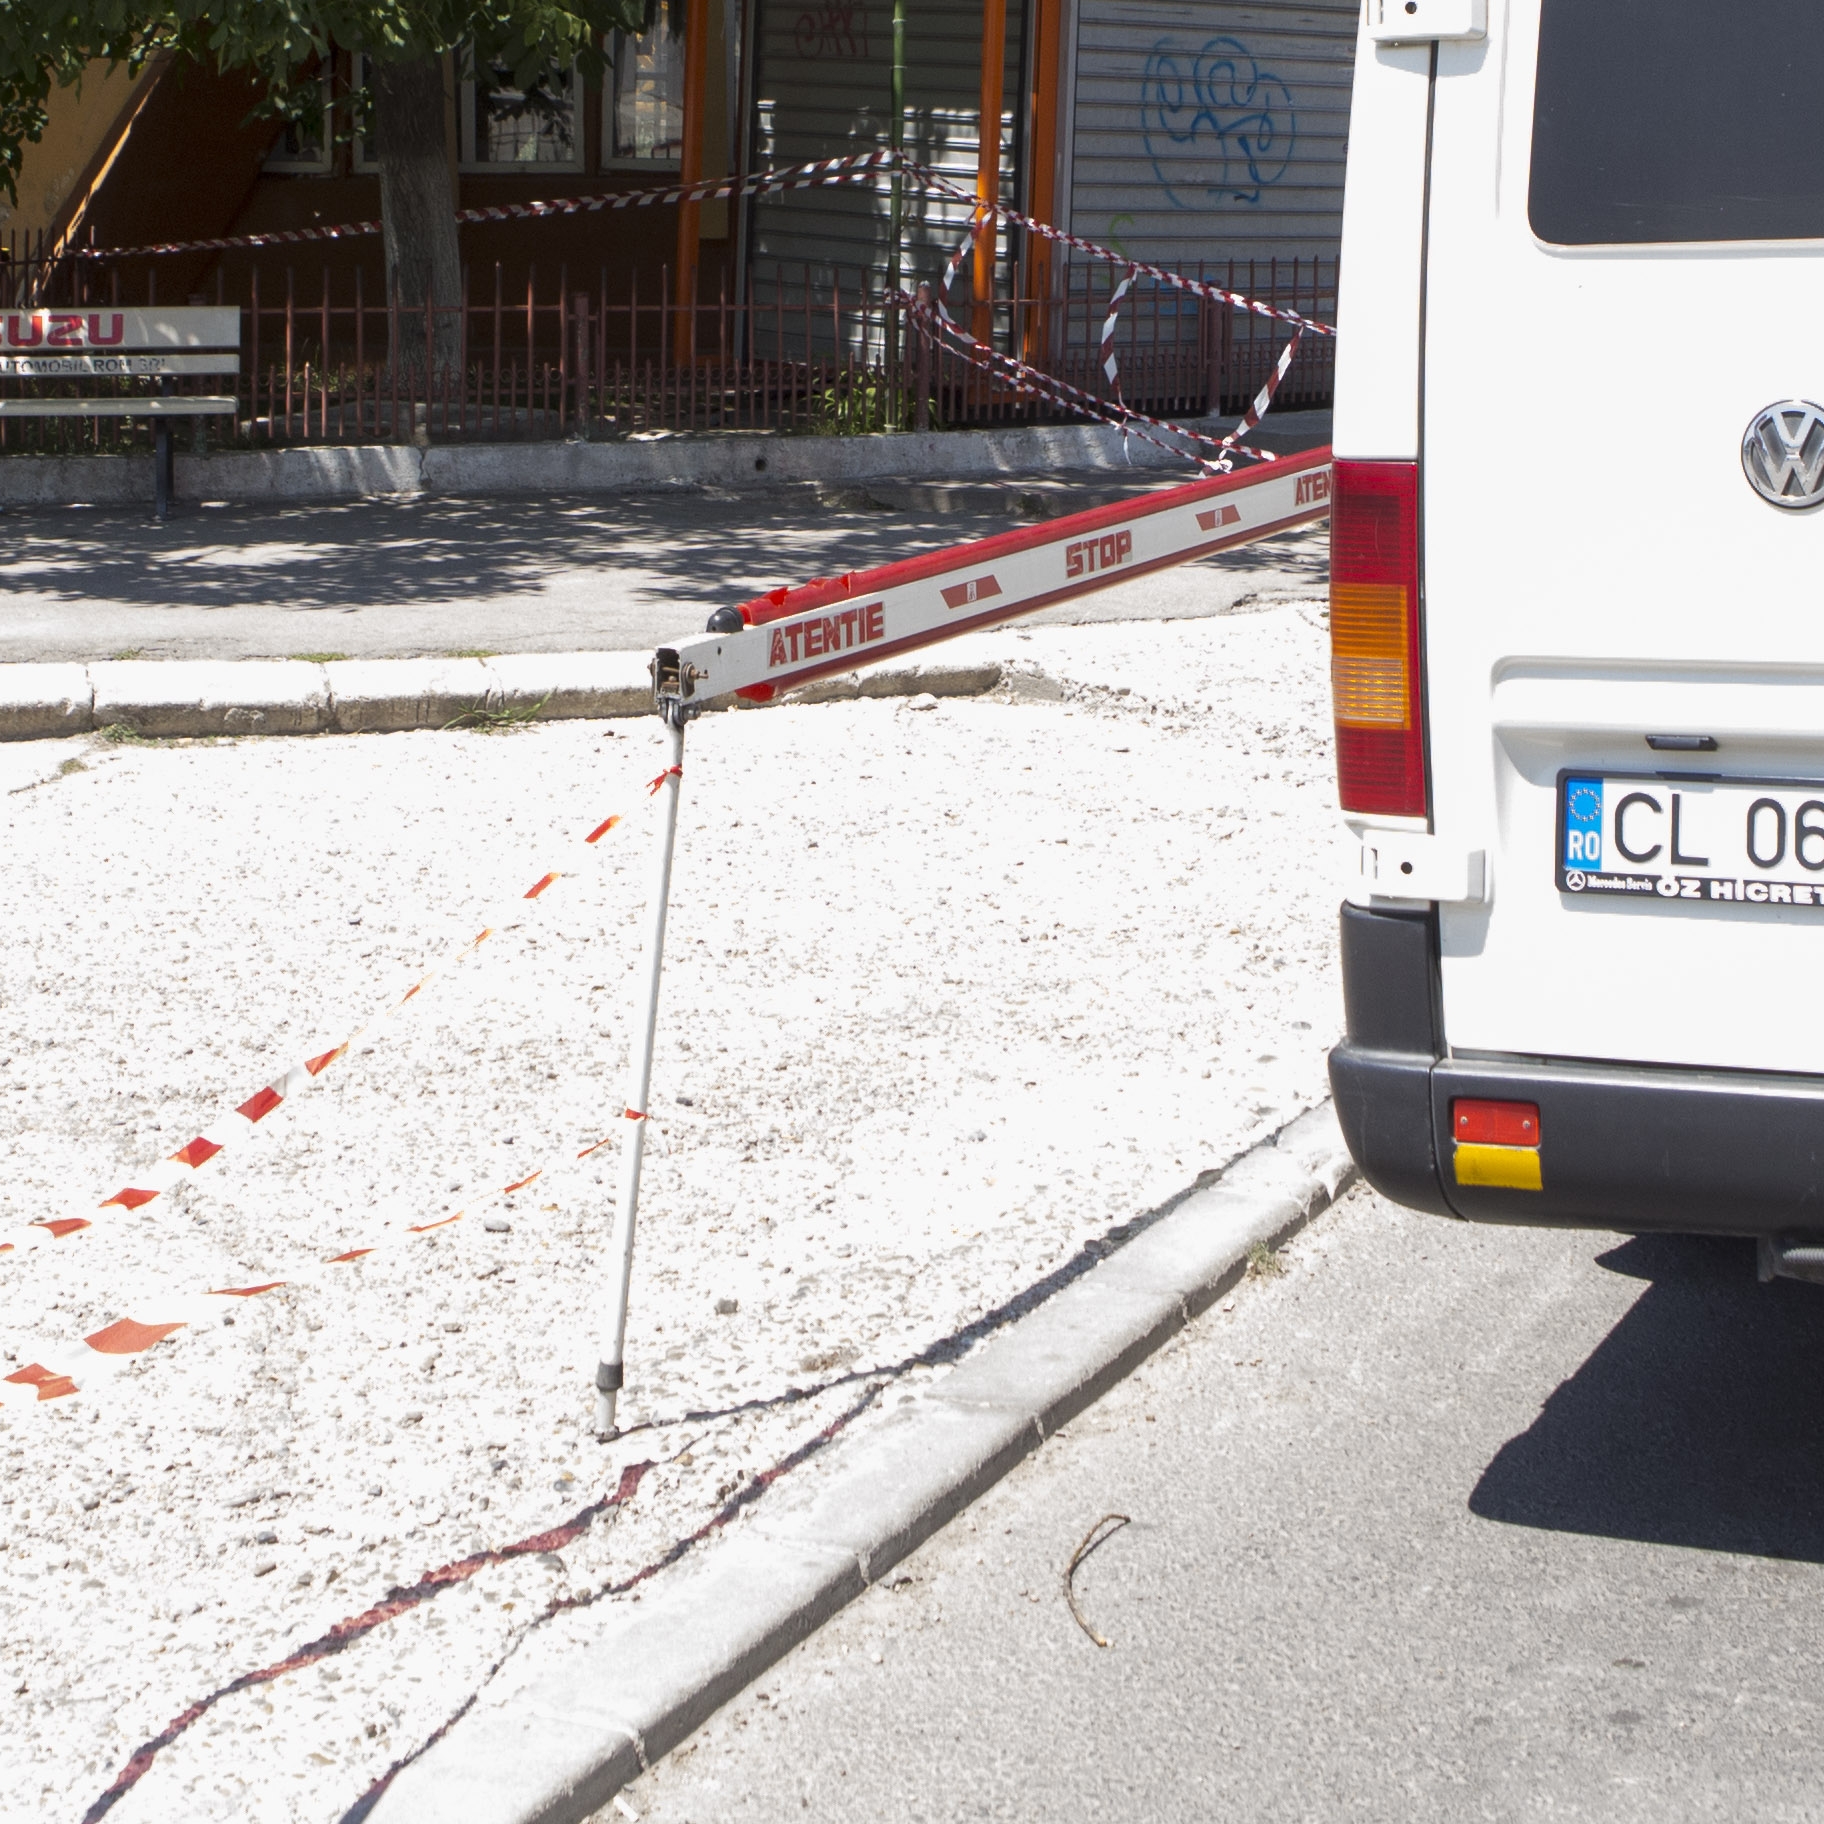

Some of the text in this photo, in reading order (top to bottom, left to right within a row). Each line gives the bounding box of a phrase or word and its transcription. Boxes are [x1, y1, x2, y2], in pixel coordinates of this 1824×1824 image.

[768, 601, 886, 668] ATENTIE
[1066, 529, 1132, 578] STOP
[1568, 830, 1601, 862] RO
[1614, 791, 1709, 867] CL
